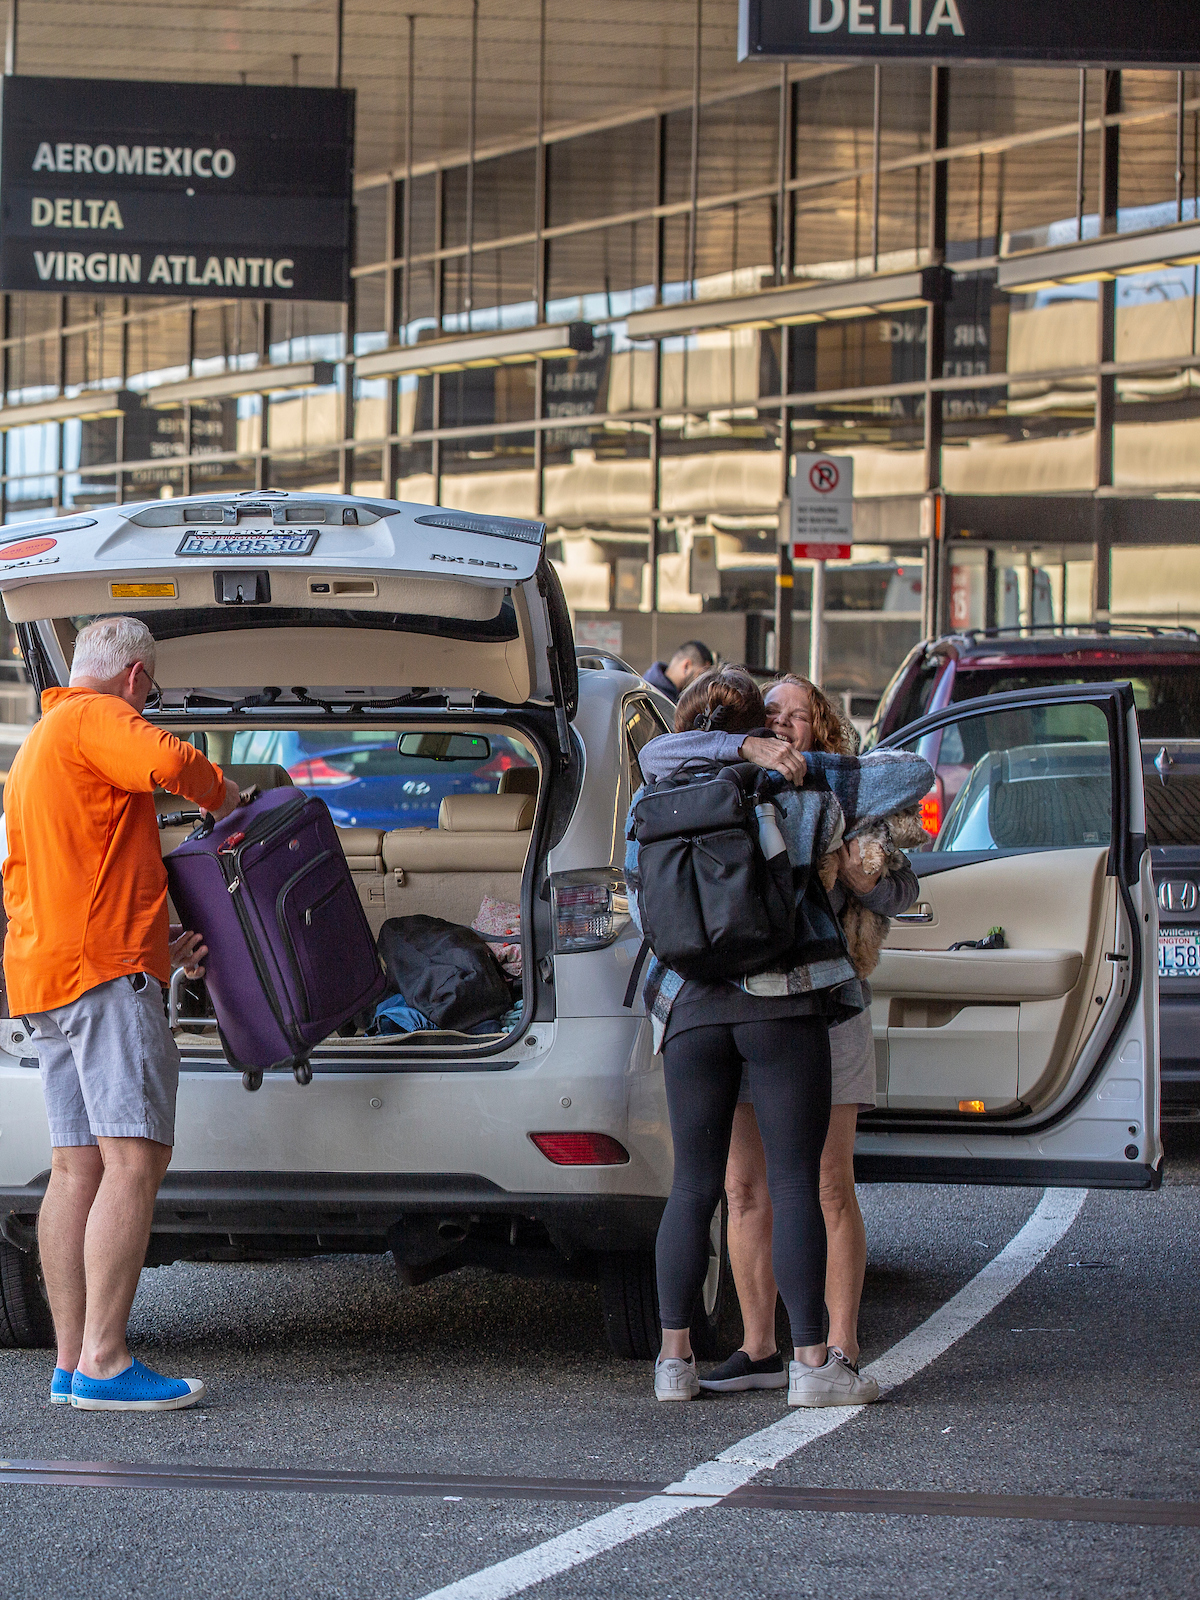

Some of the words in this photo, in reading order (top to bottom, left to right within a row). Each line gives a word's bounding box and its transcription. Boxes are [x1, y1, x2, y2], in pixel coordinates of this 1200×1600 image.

[808, 0, 965, 36] DELTA
[32, 142, 236, 178] AEROMEXICO
[31, 197, 124, 229] DELTA
[33, 251, 141, 283] VIRGIN
[148, 255, 294, 288] ATLANTIC
[186, 540, 304, 551] BJX8530
[429, 553, 464, 564] RX
